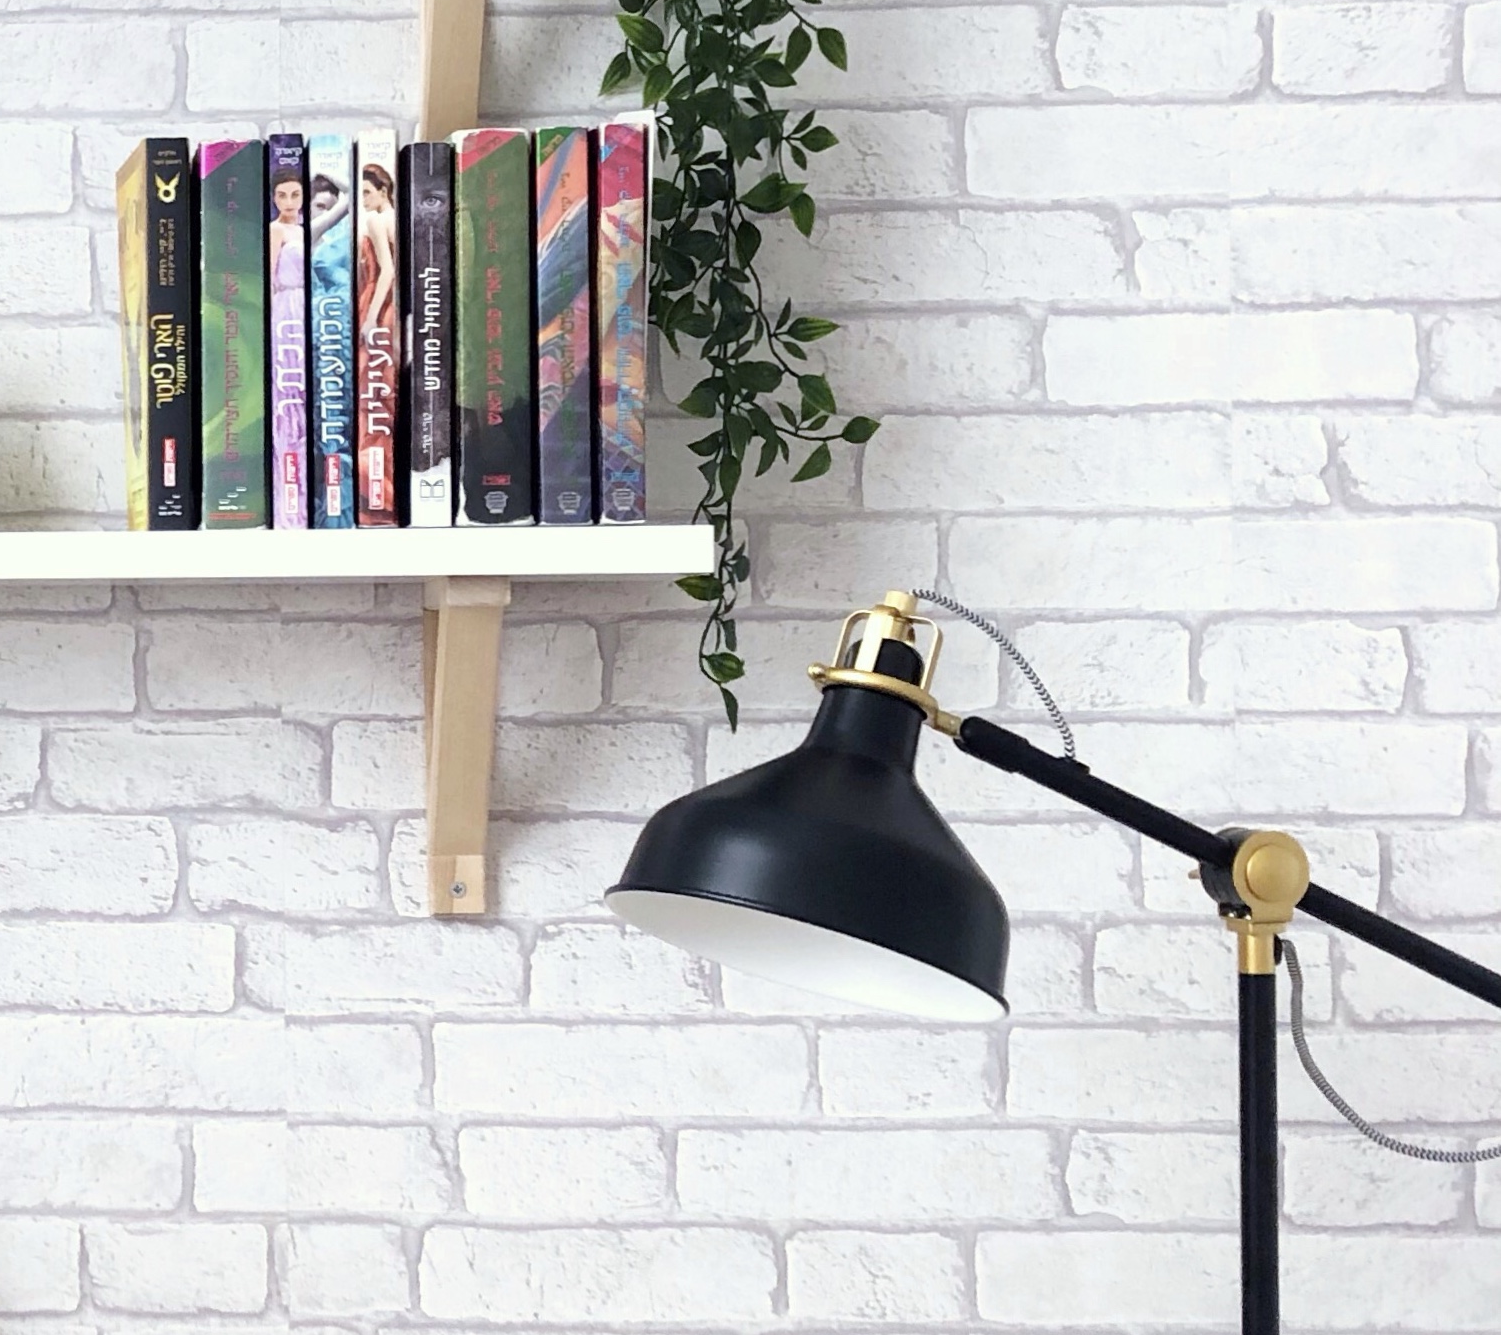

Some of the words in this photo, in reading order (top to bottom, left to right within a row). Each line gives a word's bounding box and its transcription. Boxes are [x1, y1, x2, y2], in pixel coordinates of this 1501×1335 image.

[418, 267, 441, 333] להתחיל
[485, 266, 502, 305] הארי
[150, 314, 175, 359] הארי
[150, 363, 176, 409] פוטר
[276, 318, 305, 416] הכתר
[318, 296, 346, 445] המועמדת
[360, 326, 392, 436] העילית
[424, 339, 441, 391] מחדש
[486, 390, 504, 425] האש
